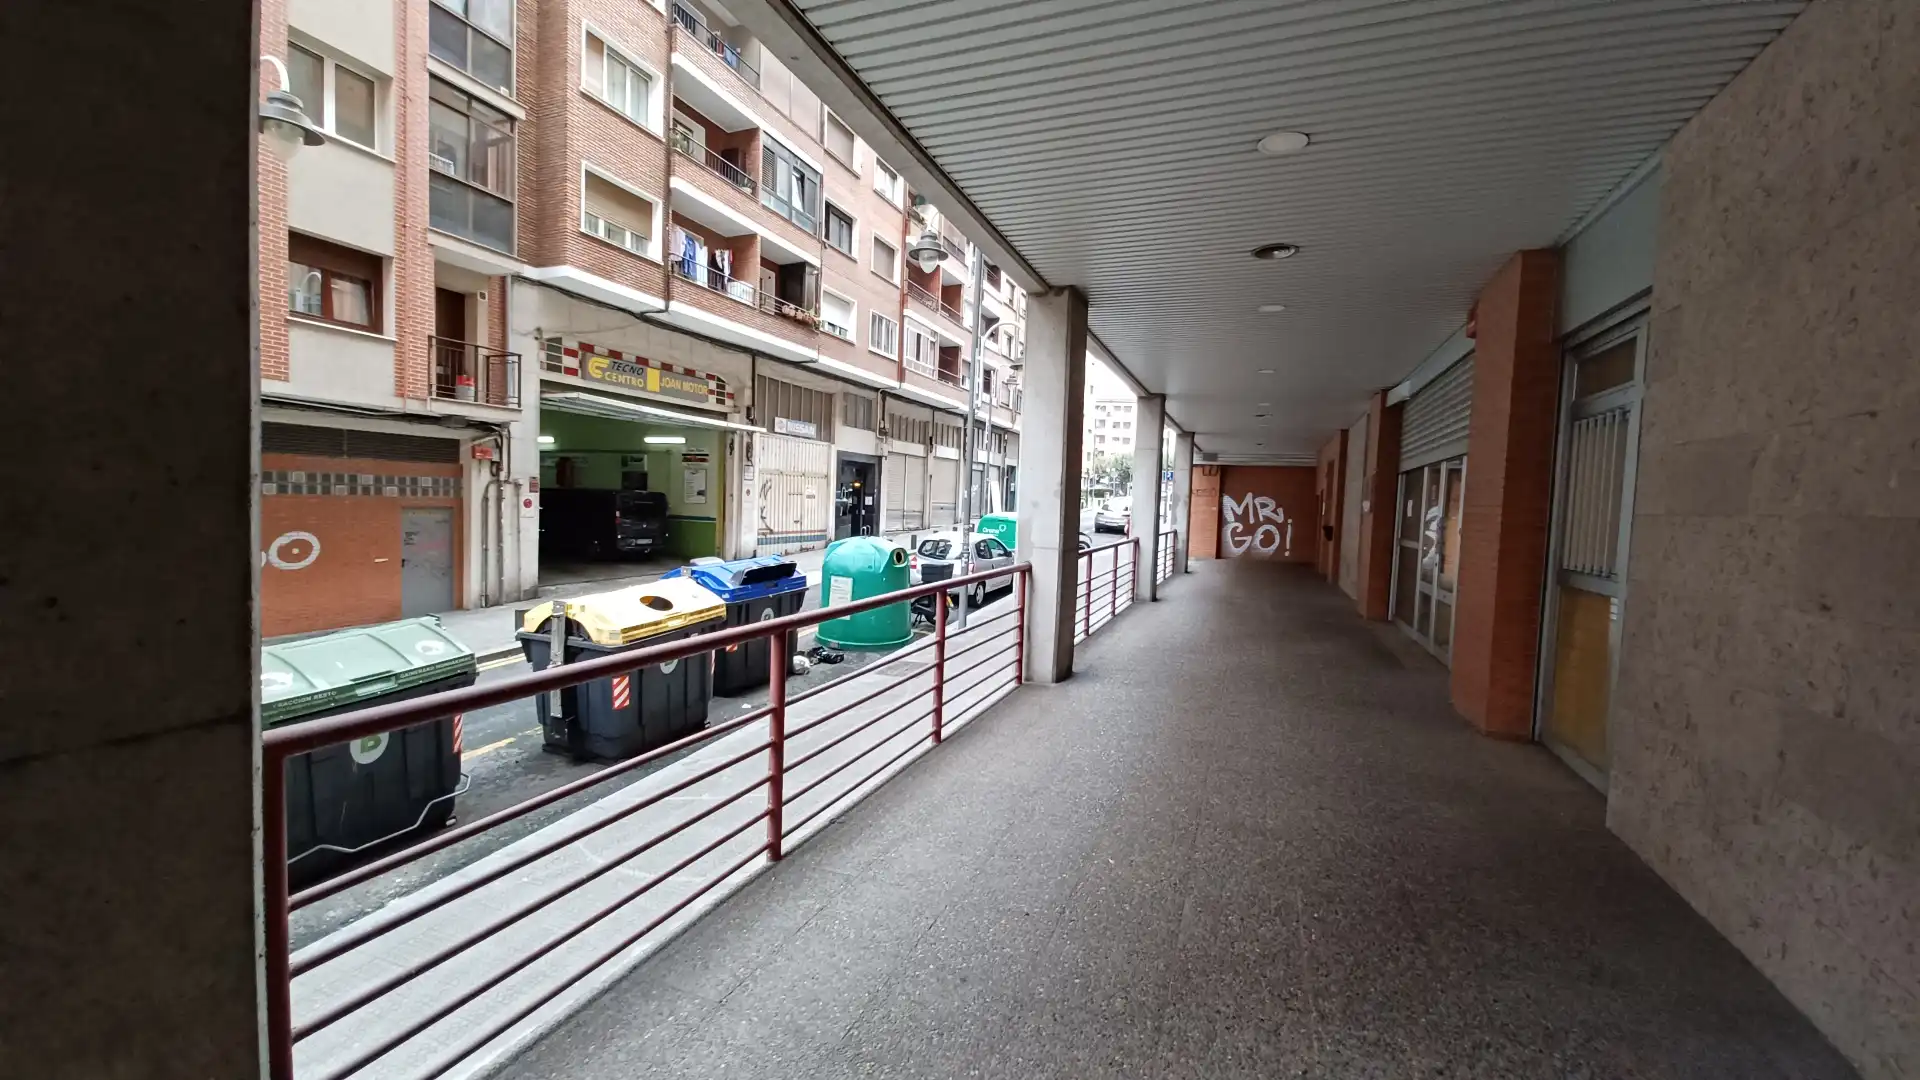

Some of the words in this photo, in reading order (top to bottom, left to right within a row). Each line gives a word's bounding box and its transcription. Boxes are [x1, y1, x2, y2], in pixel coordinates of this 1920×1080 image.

[611, 361, 645, 375] TECNO
[604, 371, 645, 388] CENTRO
[660, 377, 681, 390] JOAN
[682, 380, 709, 396] MOTOR
